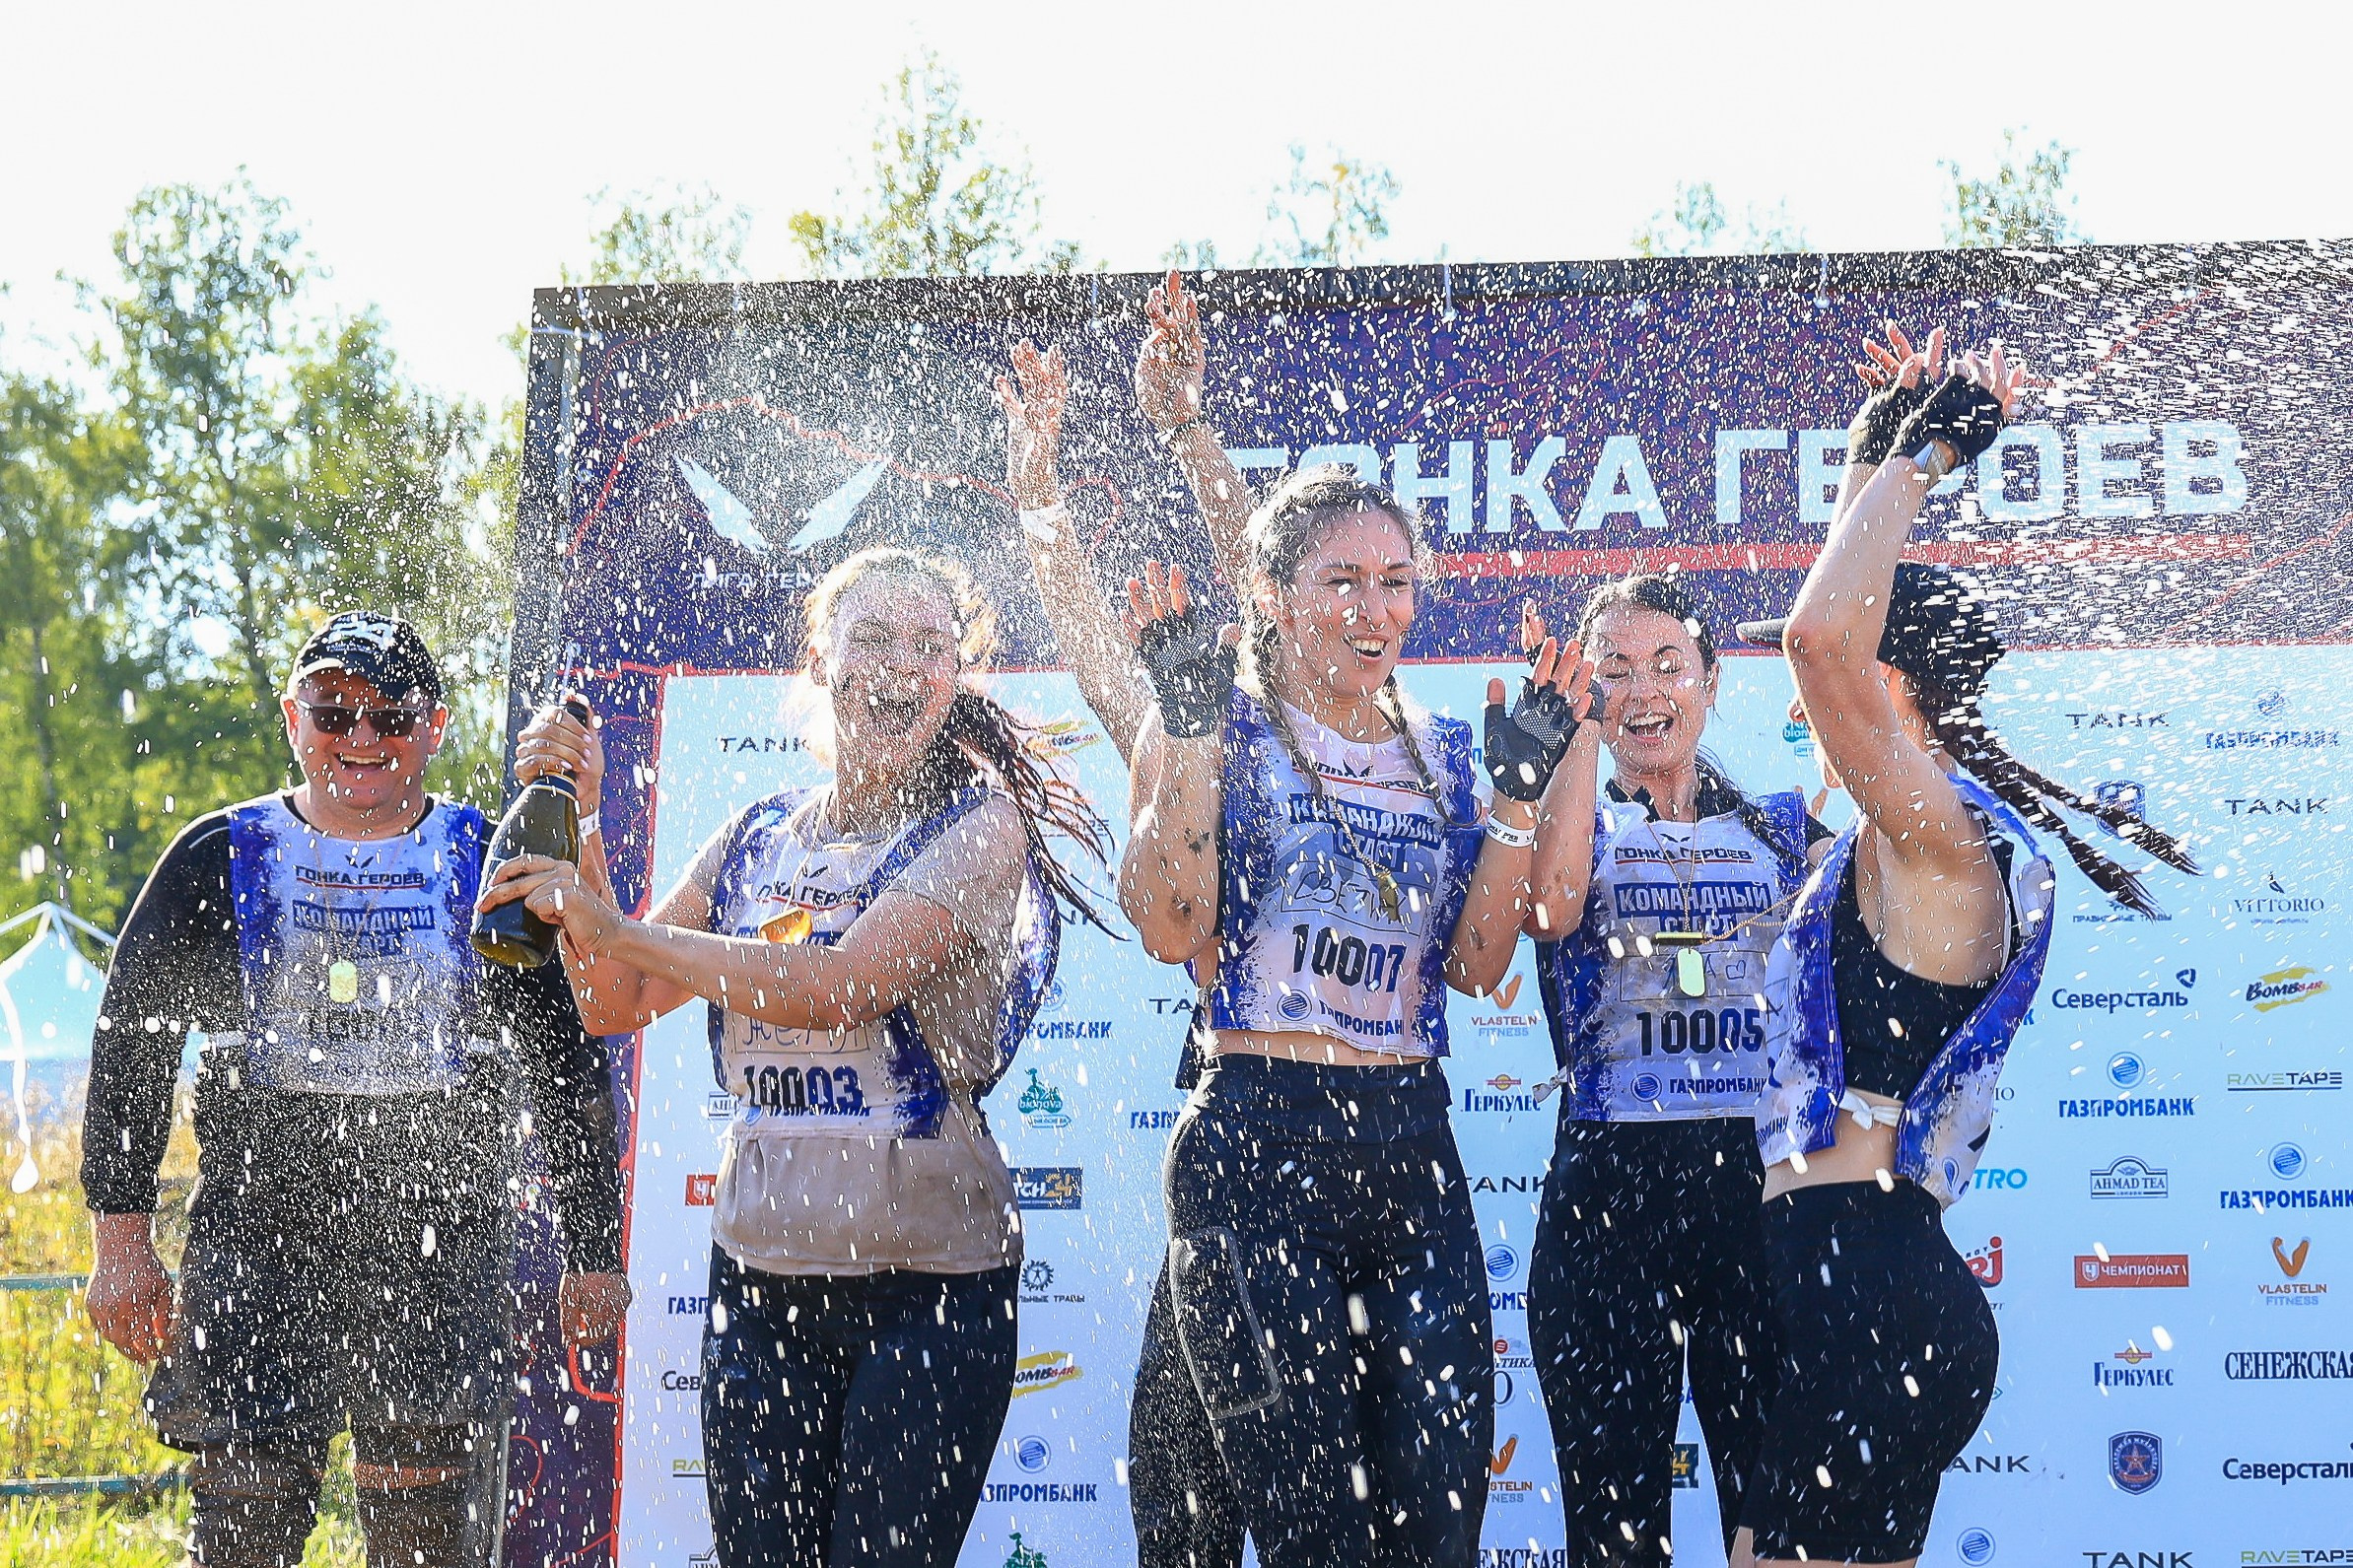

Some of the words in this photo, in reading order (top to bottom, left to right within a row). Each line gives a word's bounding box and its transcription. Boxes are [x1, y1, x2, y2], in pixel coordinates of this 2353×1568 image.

[1715, 419, 2249, 523] ГЕОЕВ
[2065, 712, 2170, 728] TANK
[716, 736, 809, 752] TANK
[2206, 731, 2340, 749] ГАЗПРОМБАНК
[2225, 798, 2328, 814] TANK
[1292, 800, 1439, 843] КАНДНЫЙ
[1616, 847, 1674, 859] ГОНКА
[1680, 847, 1753, 860] ГЕРОЕВ
[296, 866, 352, 884] ГОНКА
[358, 872, 424, 885] ГЕРОЕВ
[1618, 881, 1770, 912] КОМАНДНЫЙ
[2235, 898, 2324, 913] VITTORIO
[1292, 923, 1407, 992] 10007
[2052, 989, 2188, 1013] Северсталь
[1480, 1028, 1528, 1037] FITNESS
[1636, 1007, 1765, 1056] 10005
[744, 1065, 865, 1106] 10003
[2059, 1098, 2195, 1118] ГАЗПРОМБАНК
[2094, 1178, 2139, 1189] AHMAD
[2142, 1178, 2165, 1189] TEA
[2220, 1189, 2353, 1208] ГАЗПРОМБАНК
[2102, 1264, 2180, 1276] ЧЕМПИОНАТ
[2258, 1283, 2326, 1294] VLASTELIN
[1054, 1294, 1084, 1303] ТРАВЫ
[2266, 1296, 2318, 1306] FITNESS
[2225, 1351, 2353, 1380] СЕНЕЖСКА
[2083, 1552, 2192, 1568] TANK
